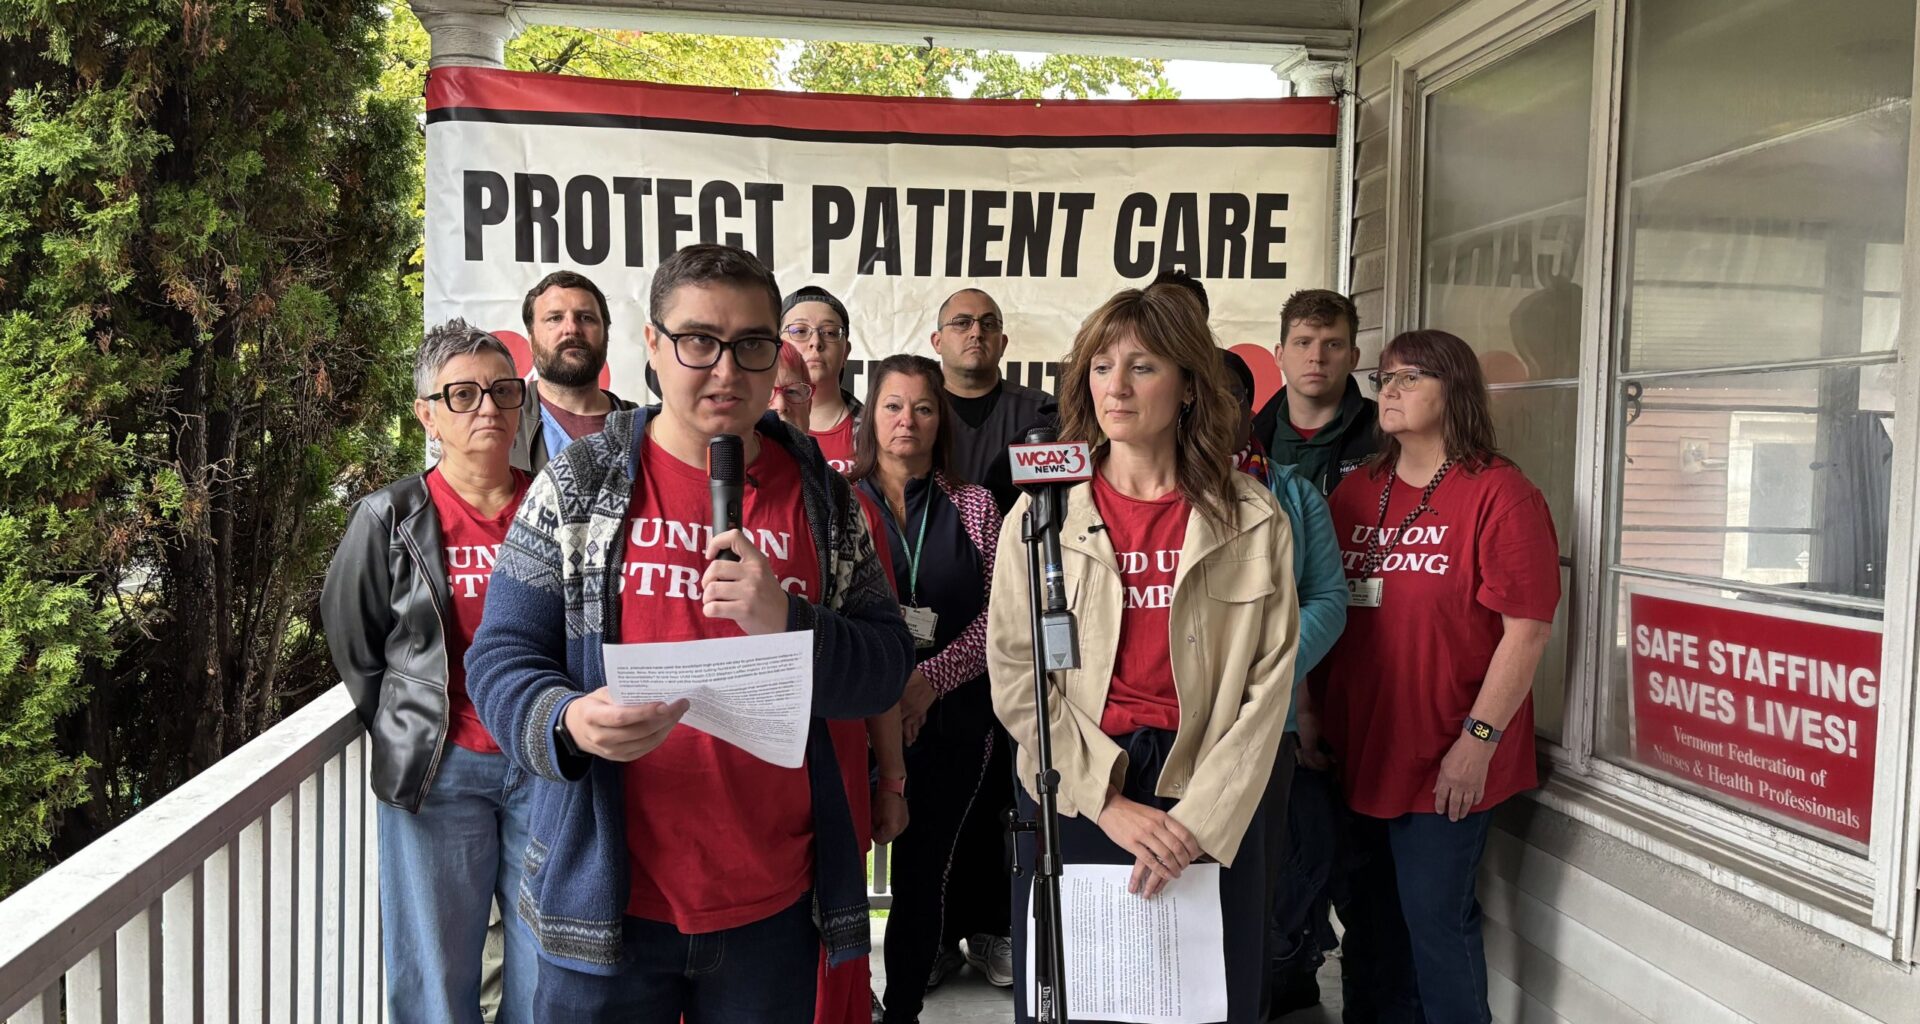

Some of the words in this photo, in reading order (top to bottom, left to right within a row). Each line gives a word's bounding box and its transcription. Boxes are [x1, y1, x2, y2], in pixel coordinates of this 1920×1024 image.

[463, 170, 784, 272] PROTECT
[812, 184, 1096, 278] PATIENT
[1113, 192, 1289, 280] CARE
[1016, 450, 1070, 466] WCAX
[1067, 445, 1086, 474] 3
[1035, 465, 1066, 474] NEWS
[630, 518, 791, 561] UNIN
[1341, 550, 1449, 575] TONG
[1636, 624, 1699, 669] SAFE
[1708, 640, 1877, 707] STAFFING
[1649, 672, 1736, 724] SAVES
[1746, 696, 1857, 758] LIVES!
[1654, 744, 1690, 772] Nurses
[1693, 761, 1704, 778] &
[1708, 764, 1754, 794] Health
[1758, 782, 1860, 829] Professionals
[1673, 726, 1724, 757] Vermont
[1728, 743, 1806, 782] Federation
[1811, 770, 1827, 788] of
